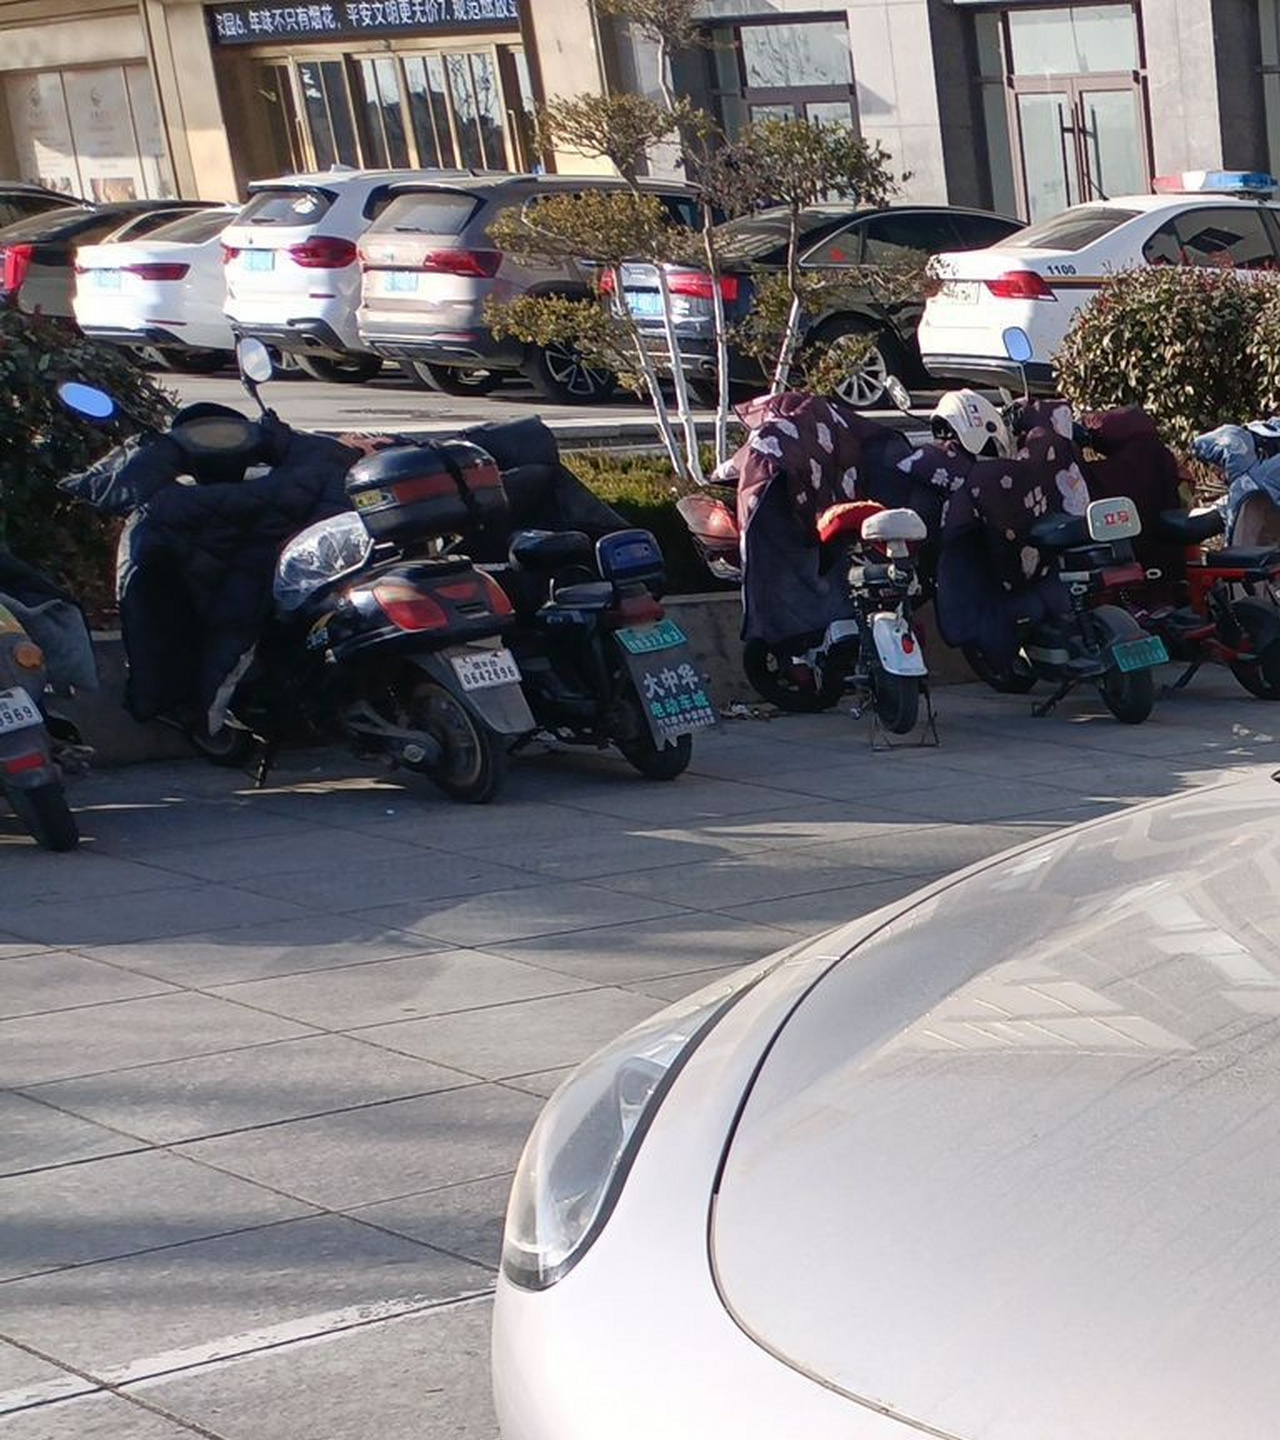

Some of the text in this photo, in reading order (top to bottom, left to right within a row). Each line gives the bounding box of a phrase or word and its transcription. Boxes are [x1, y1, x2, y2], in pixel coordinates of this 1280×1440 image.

[1047, 264, 1077, 275] 1100
[644, 663, 699, 698] 大中华
